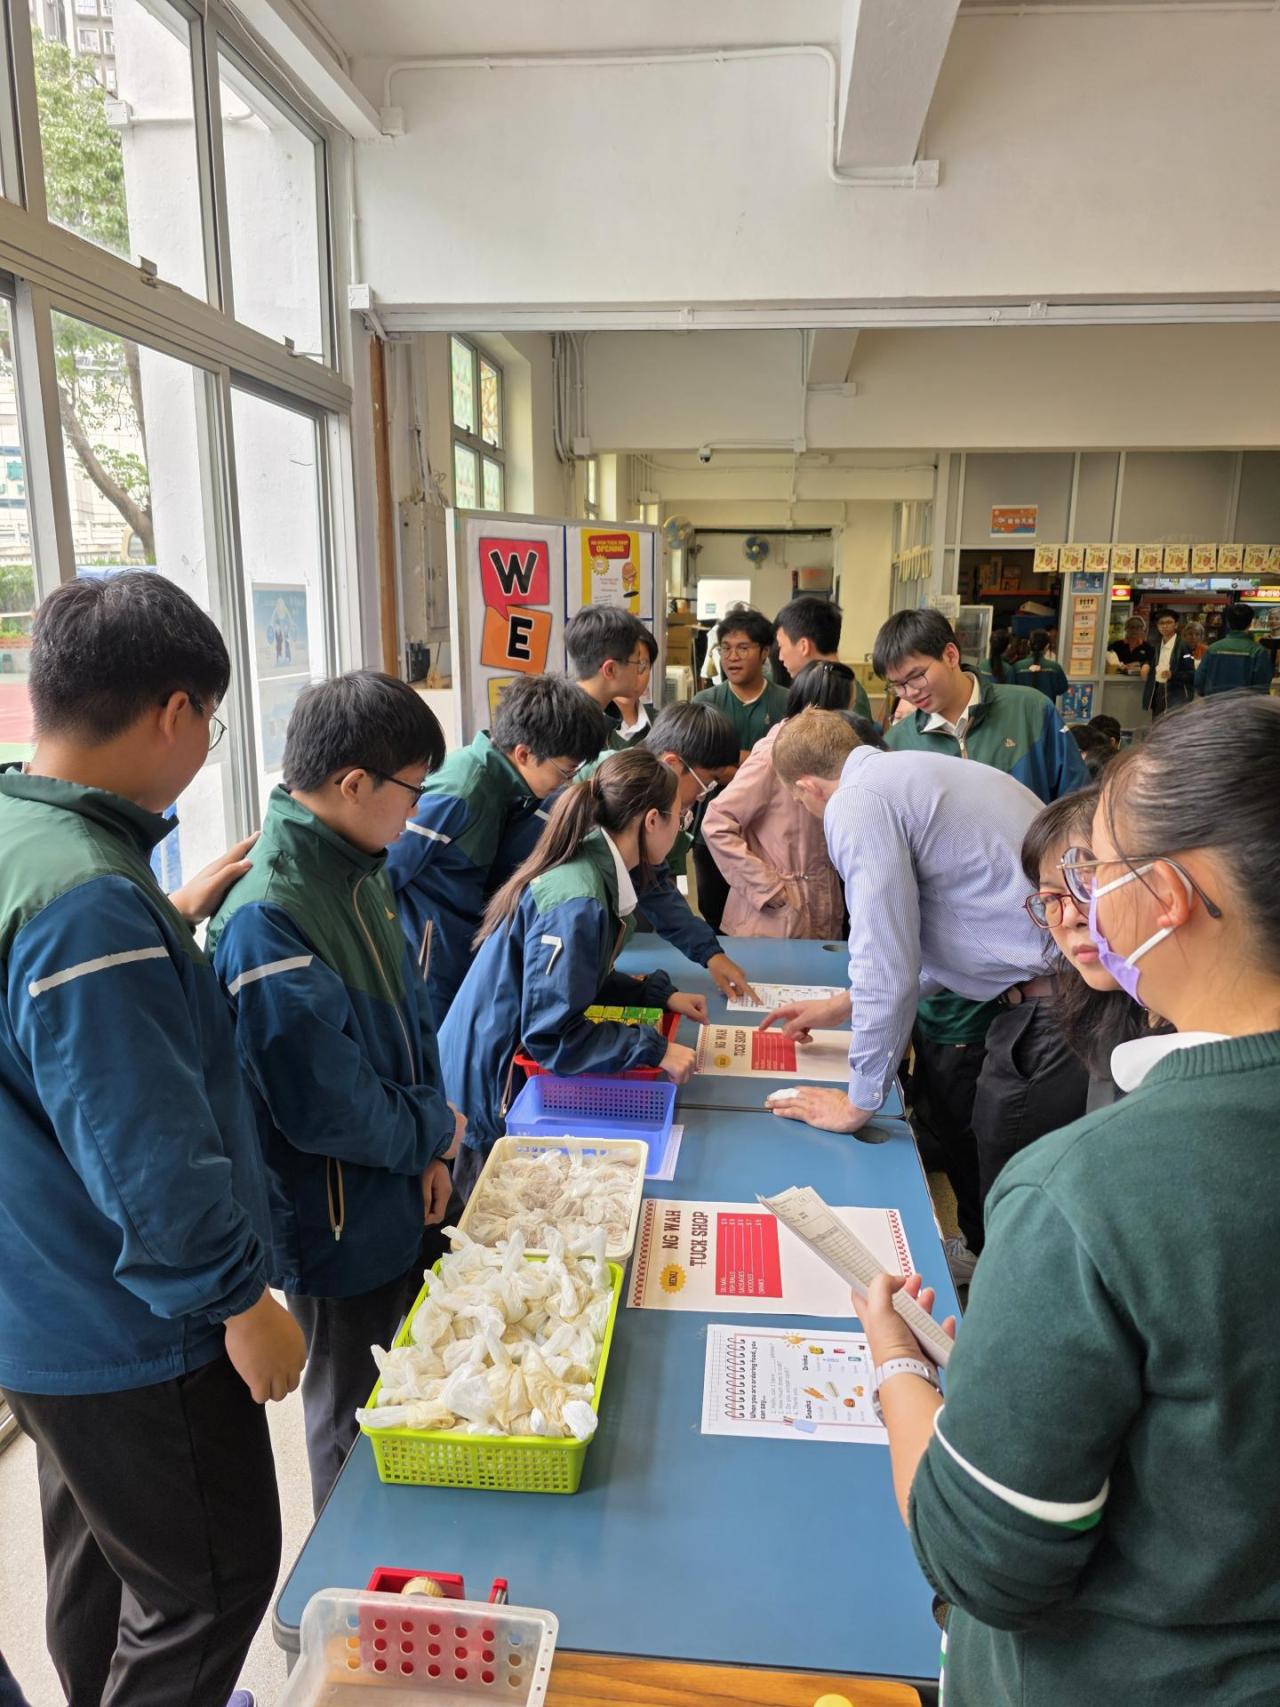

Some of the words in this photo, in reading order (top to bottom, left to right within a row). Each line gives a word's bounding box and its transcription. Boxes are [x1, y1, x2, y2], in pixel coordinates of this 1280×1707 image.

[596, 545, 624, 553] OPENING
[664, 1210, 682, 1232] WAH
[691, 1211, 709, 1237] SHOP
[662, 1235, 680, 1250] NG
[690, 1240, 708, 1267] TUCK
[669, 1271, 678, 1286] MENU
